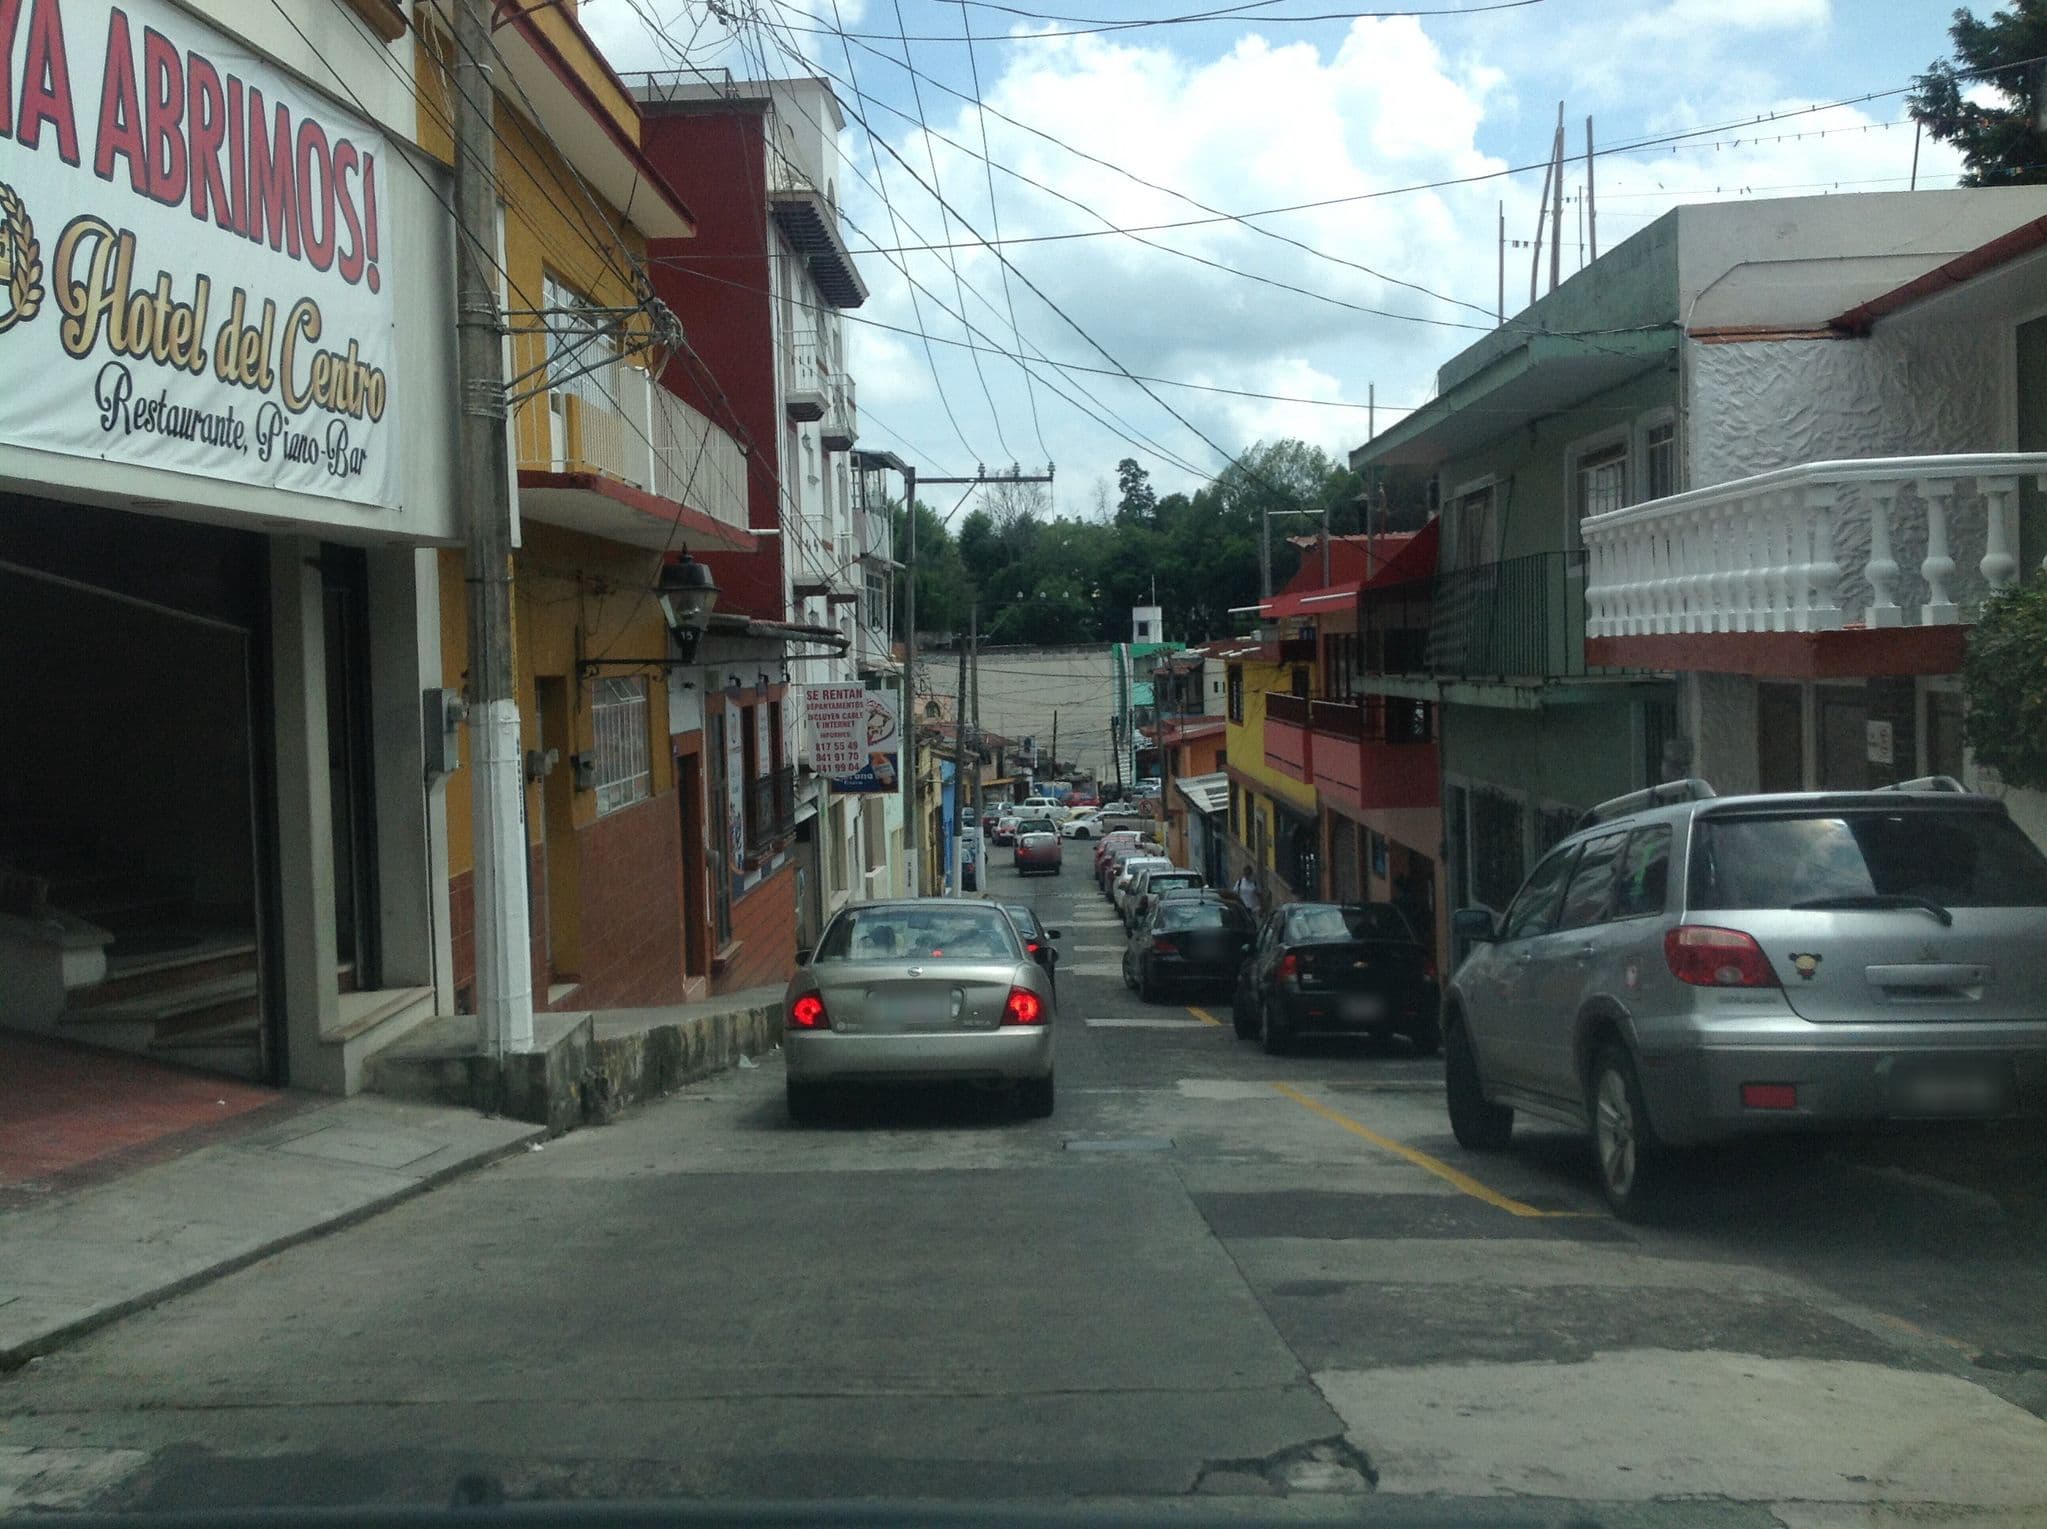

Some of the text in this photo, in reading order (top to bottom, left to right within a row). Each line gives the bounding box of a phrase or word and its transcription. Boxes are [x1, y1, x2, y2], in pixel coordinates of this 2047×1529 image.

[94, 6, 380, 295] ABRIMOS!
[52, 214, 387, 424] Hotel del Centro
[95, 361, 367, 478] Restaurante, Piano-Bar
[806, 688, 863, 701] SE RENTAN
[834, 742, 845, 750] 55
[848, 741, 858, 749] 49
[815, 752, 859, 762] 841 91 70
[835, 763, 846, 771] 99
[848, 763, 859, 771] 04
